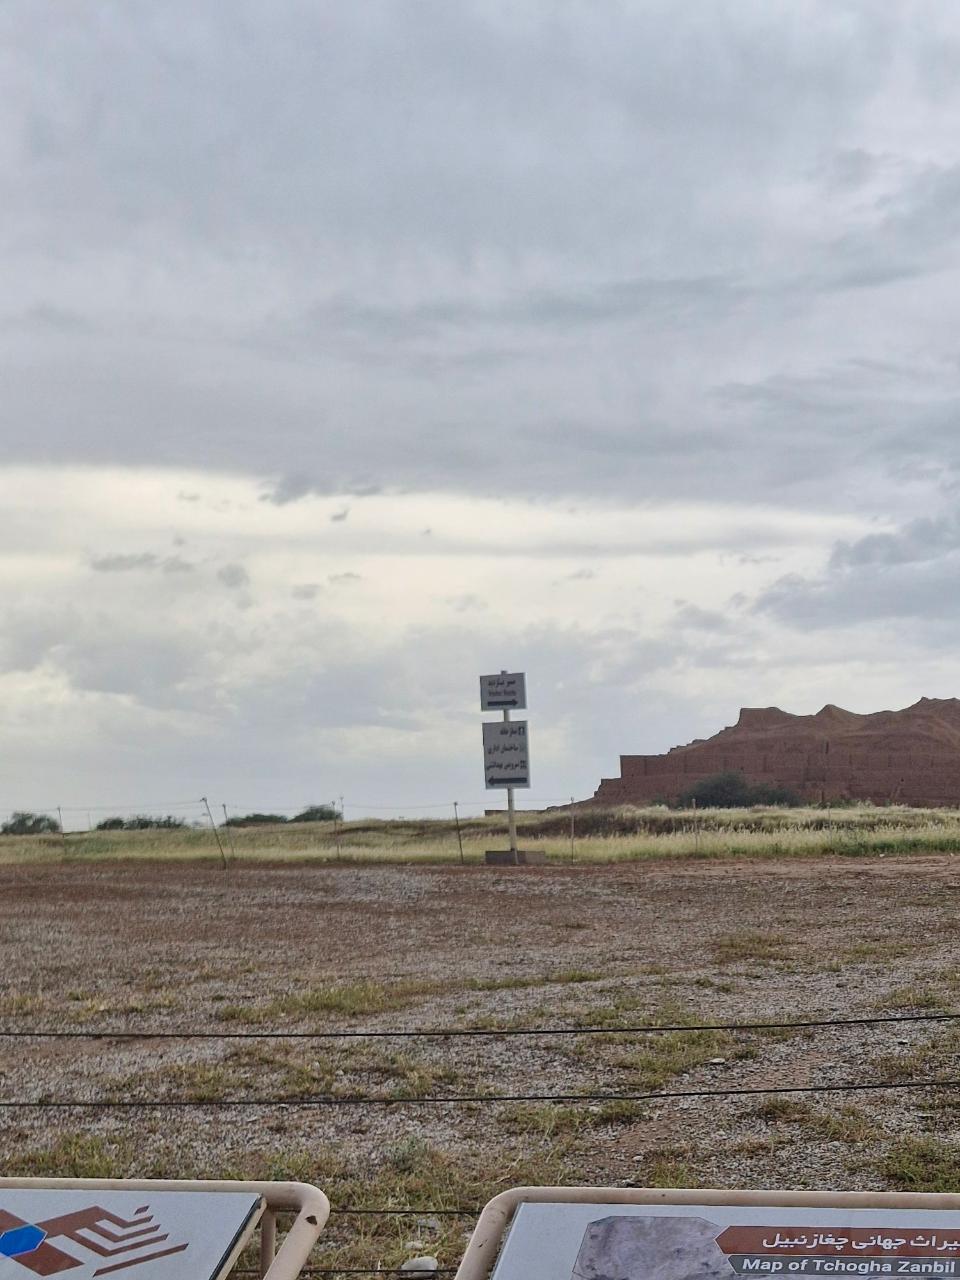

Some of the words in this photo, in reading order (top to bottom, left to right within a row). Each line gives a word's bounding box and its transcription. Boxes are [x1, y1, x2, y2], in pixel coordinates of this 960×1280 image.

[851, 1234, 907, 1250] جهانی
[742, 1258, 783, 1272] Map
[788, 1258, 808, 1271] of
[812, 1259, 892, 1275] Tchogha
[897, 1260, 956, 1273] Zanbil
